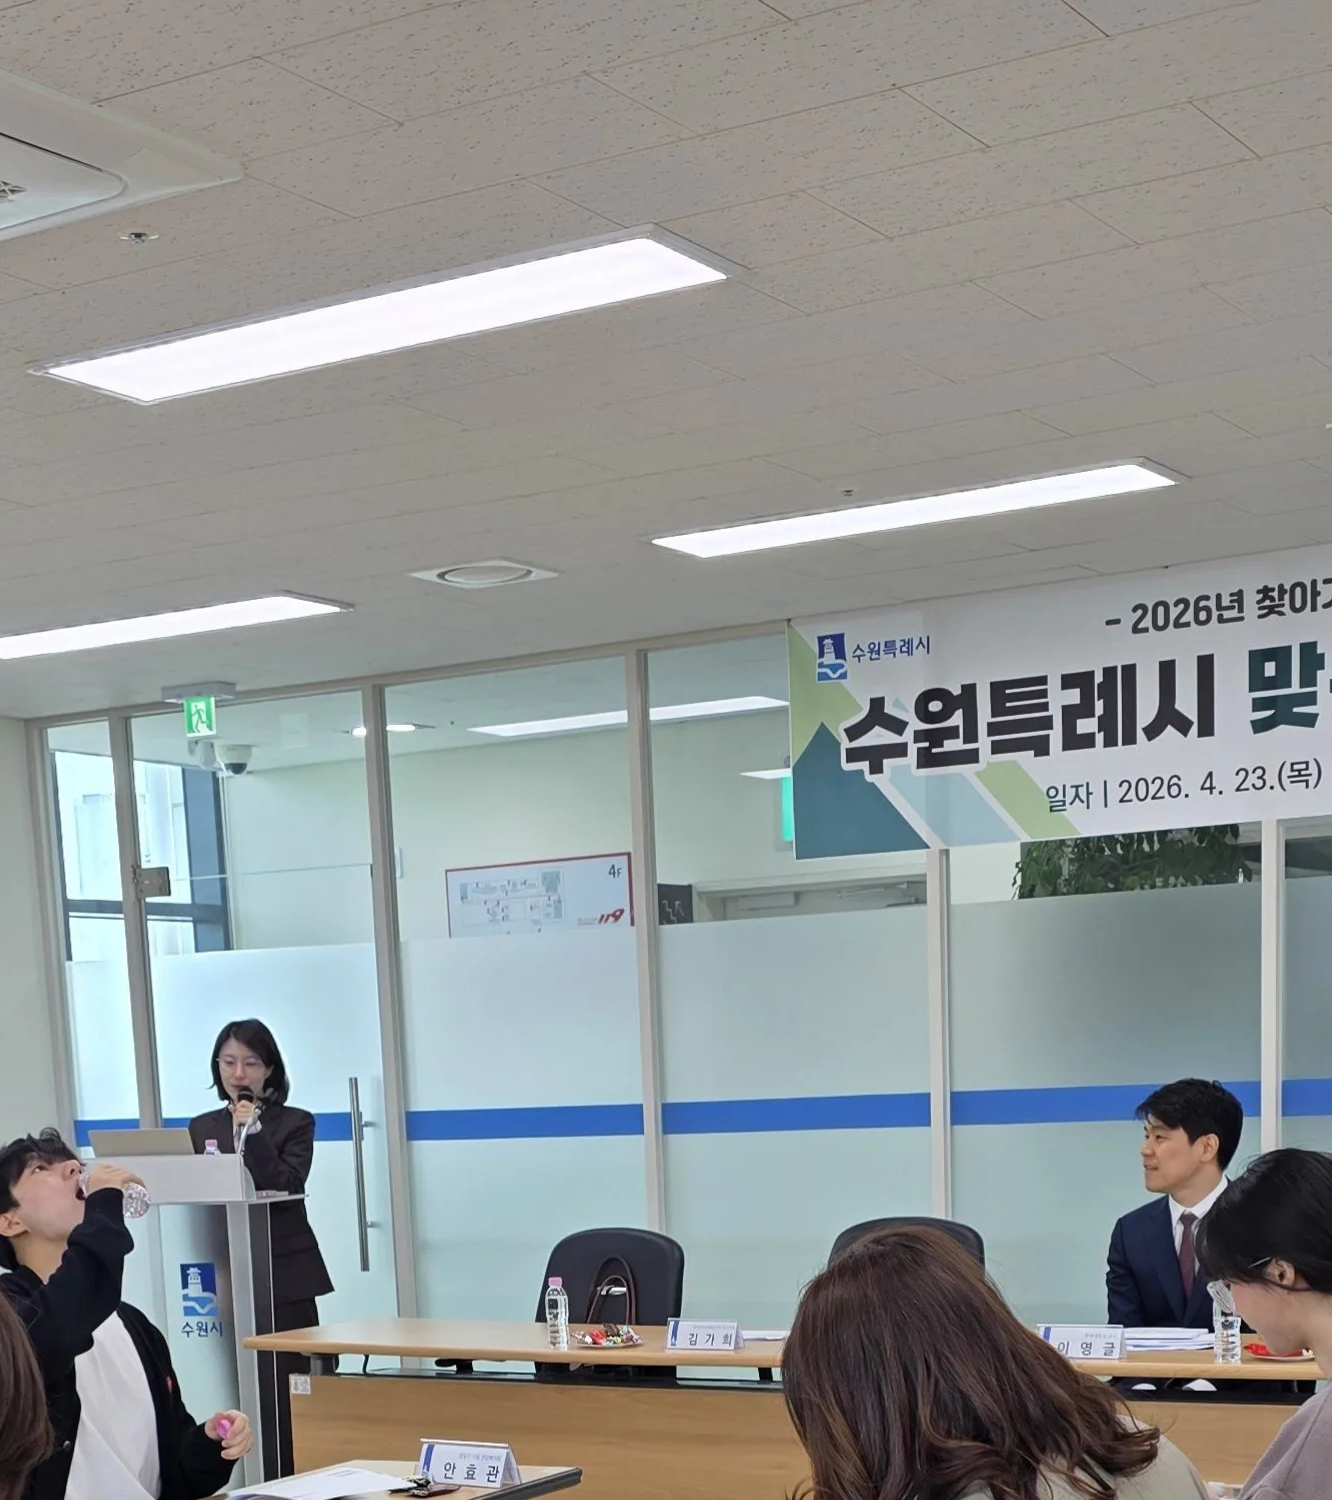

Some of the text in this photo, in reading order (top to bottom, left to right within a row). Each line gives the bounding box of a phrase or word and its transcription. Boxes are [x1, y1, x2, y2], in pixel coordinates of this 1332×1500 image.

[1130, 589, 1247, 635] 2026년
[851, 635, 931, 664] 수원특례시
[843, 652, 1216, 776] 수원특례시
[1046, 781, 1094, 813] 일자
[1118, 773, 1190, 806] 2026.
[1200, 770, 1224, 798] 4.
[1235, 756, 1323, 793] 23.(목)
[608, 864, 622, 878] 4F
[597, 908, 625, 924] 119
[181, 1321, 223, 1338] 수원시
